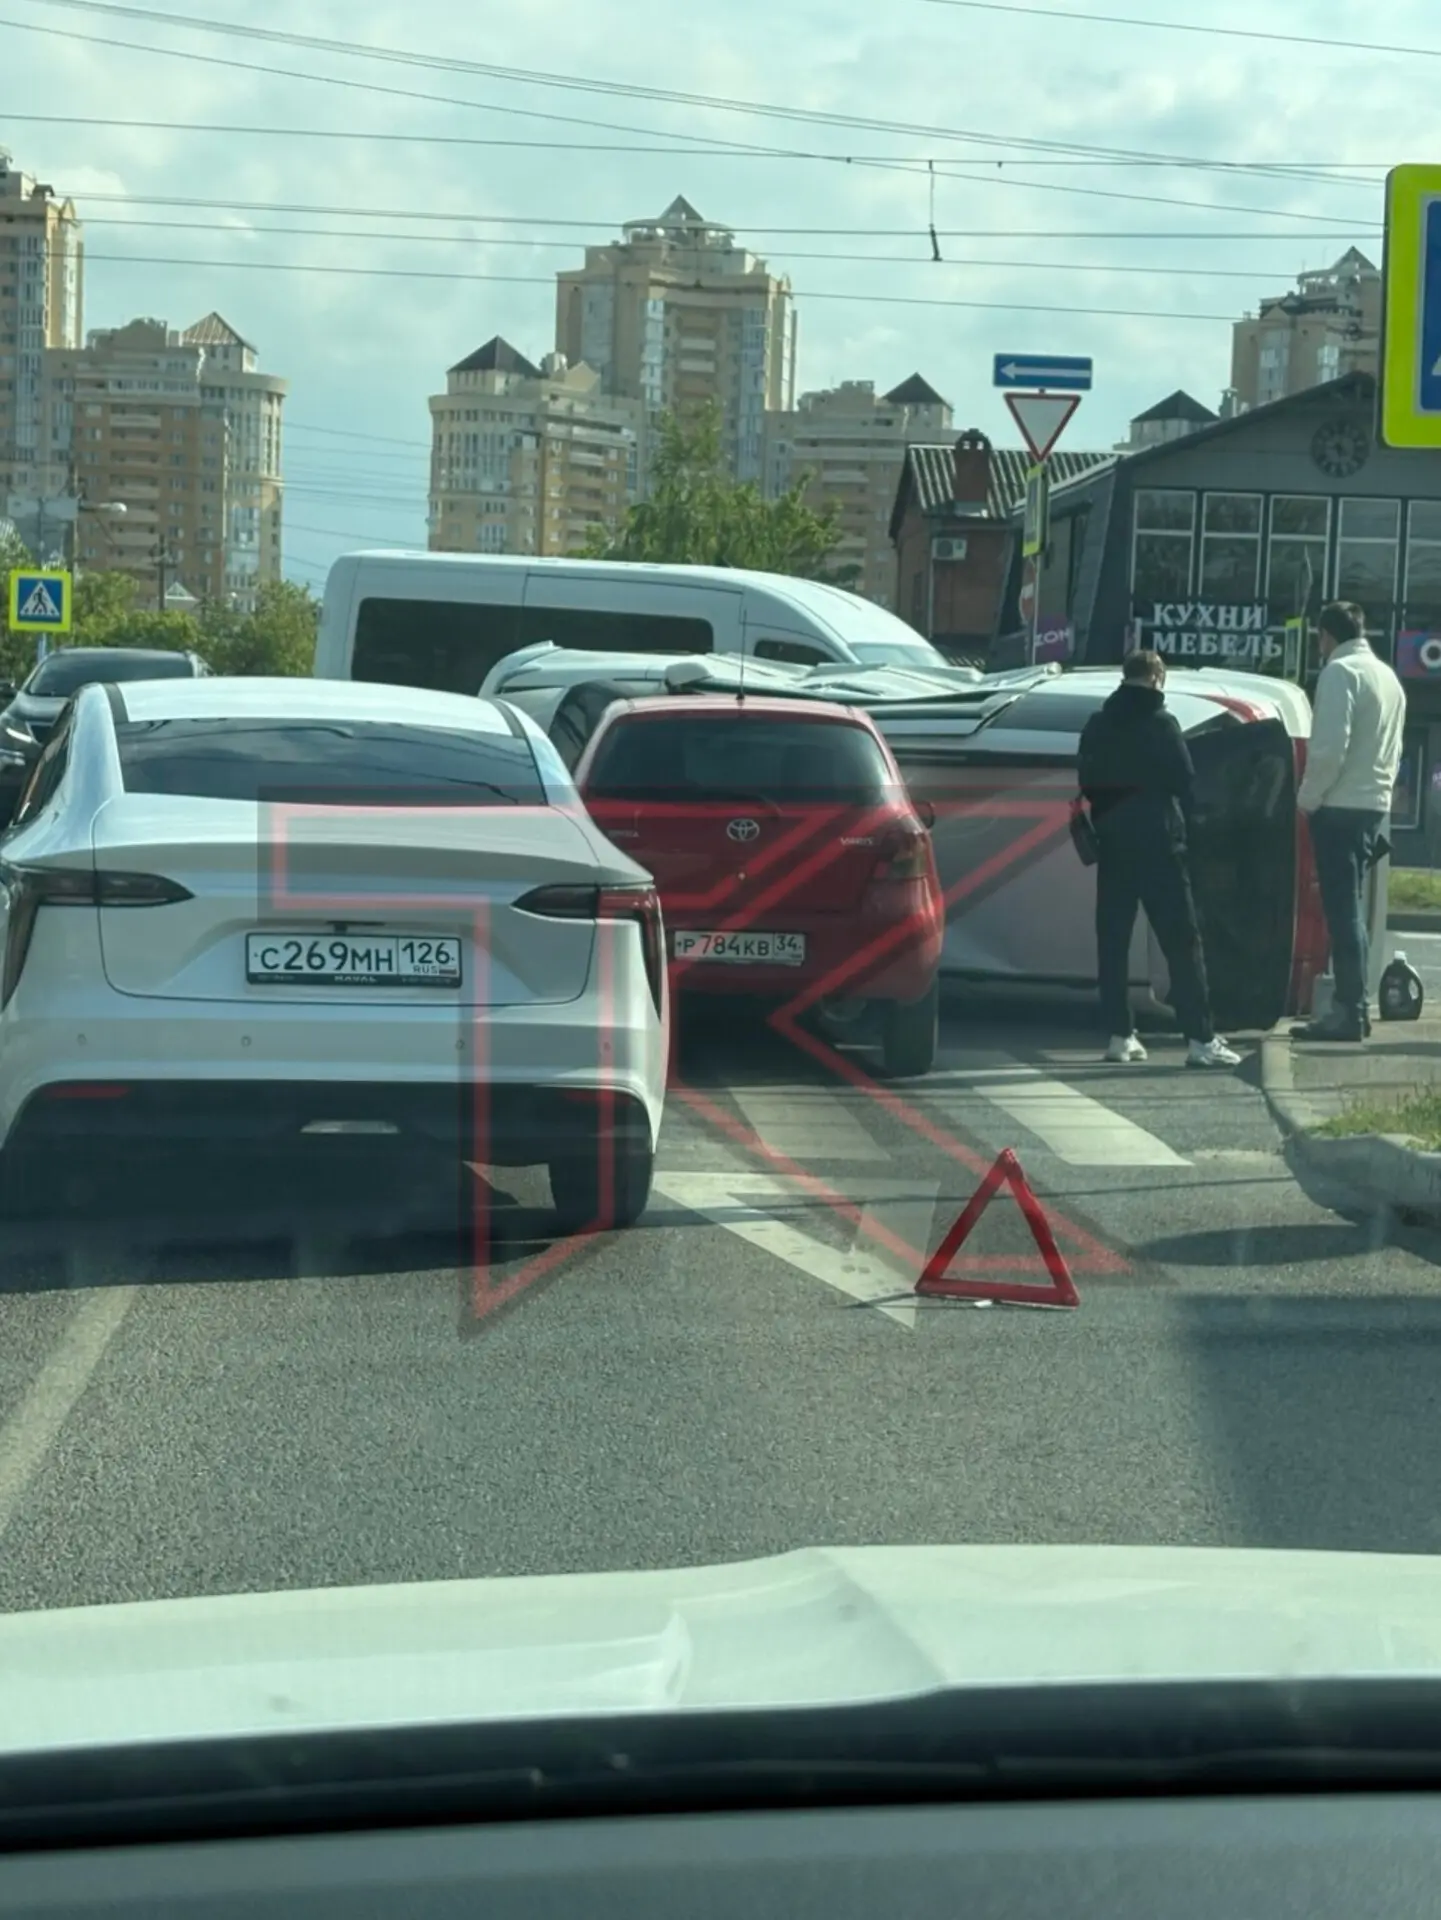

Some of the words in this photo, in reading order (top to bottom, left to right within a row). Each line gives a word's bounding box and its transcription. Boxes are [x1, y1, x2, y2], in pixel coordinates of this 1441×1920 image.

[1153, 602, 1263, 630] КУХНИ
[1152, 631, 1283, 657] МЕБЕЛЬ
[260, 940, 393, 972] С269МН
[402, 942, 450, 965] 126
[682, 934, 770, 956] Р784КВ
[776, 935, 798, 951] 34
[413, 965, 438, 974] RUS
